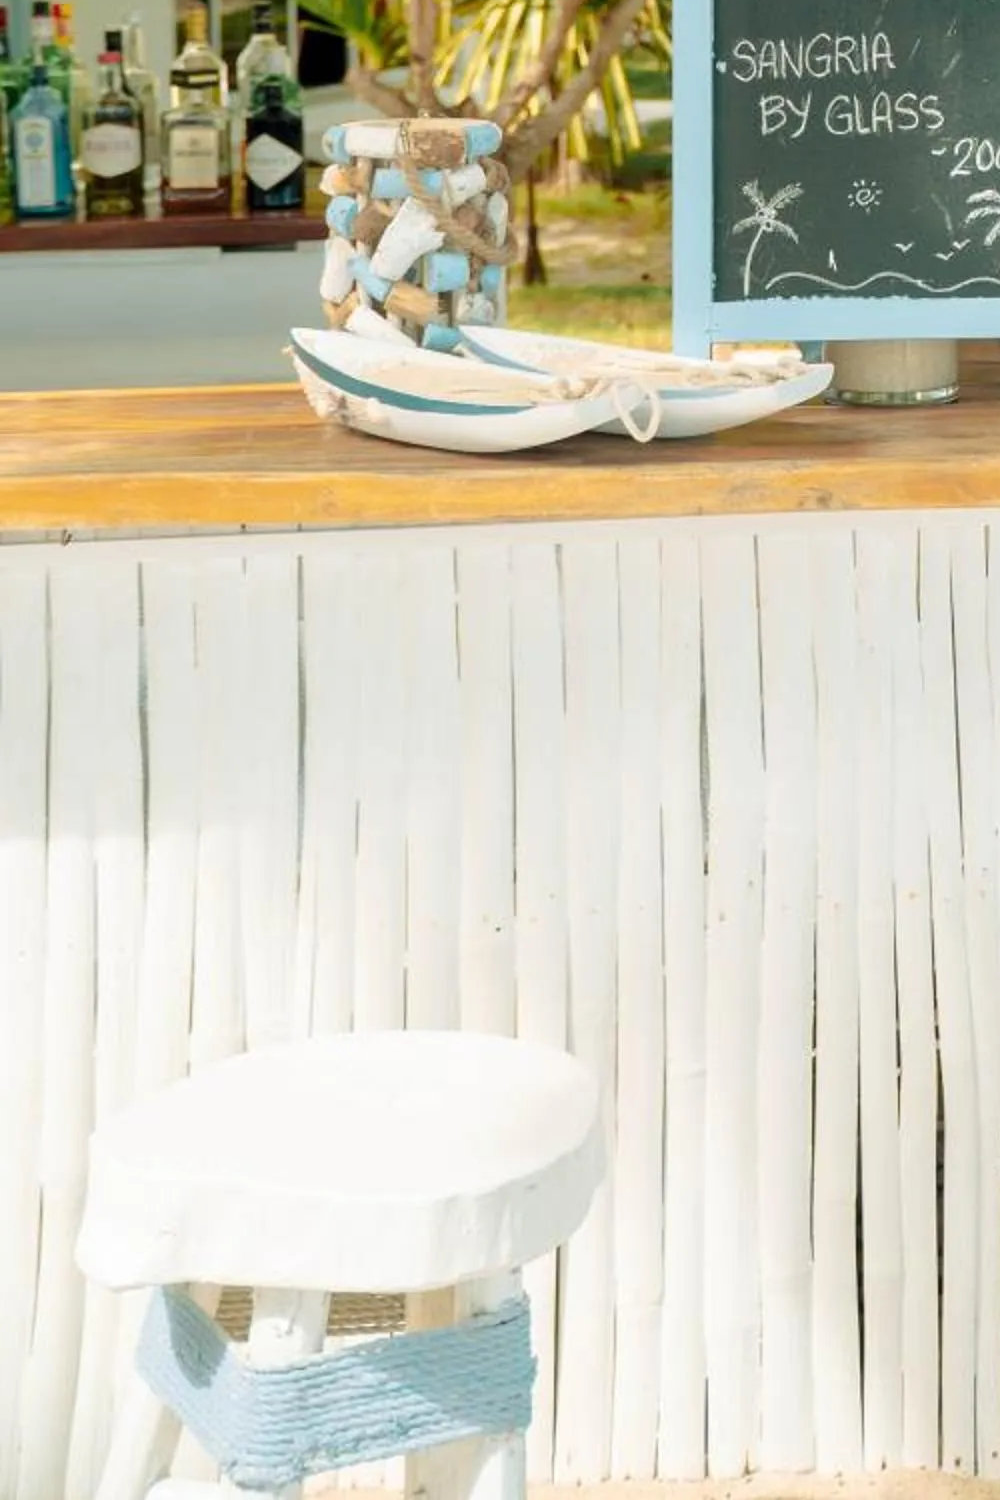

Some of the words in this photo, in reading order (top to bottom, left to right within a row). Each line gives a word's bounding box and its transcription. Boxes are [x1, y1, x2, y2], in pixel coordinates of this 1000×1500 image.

[732, 33, 897, 83] SANGRIA
[758, 92, 812, 139] BY
[824, 91, 946, 135] GLASS
